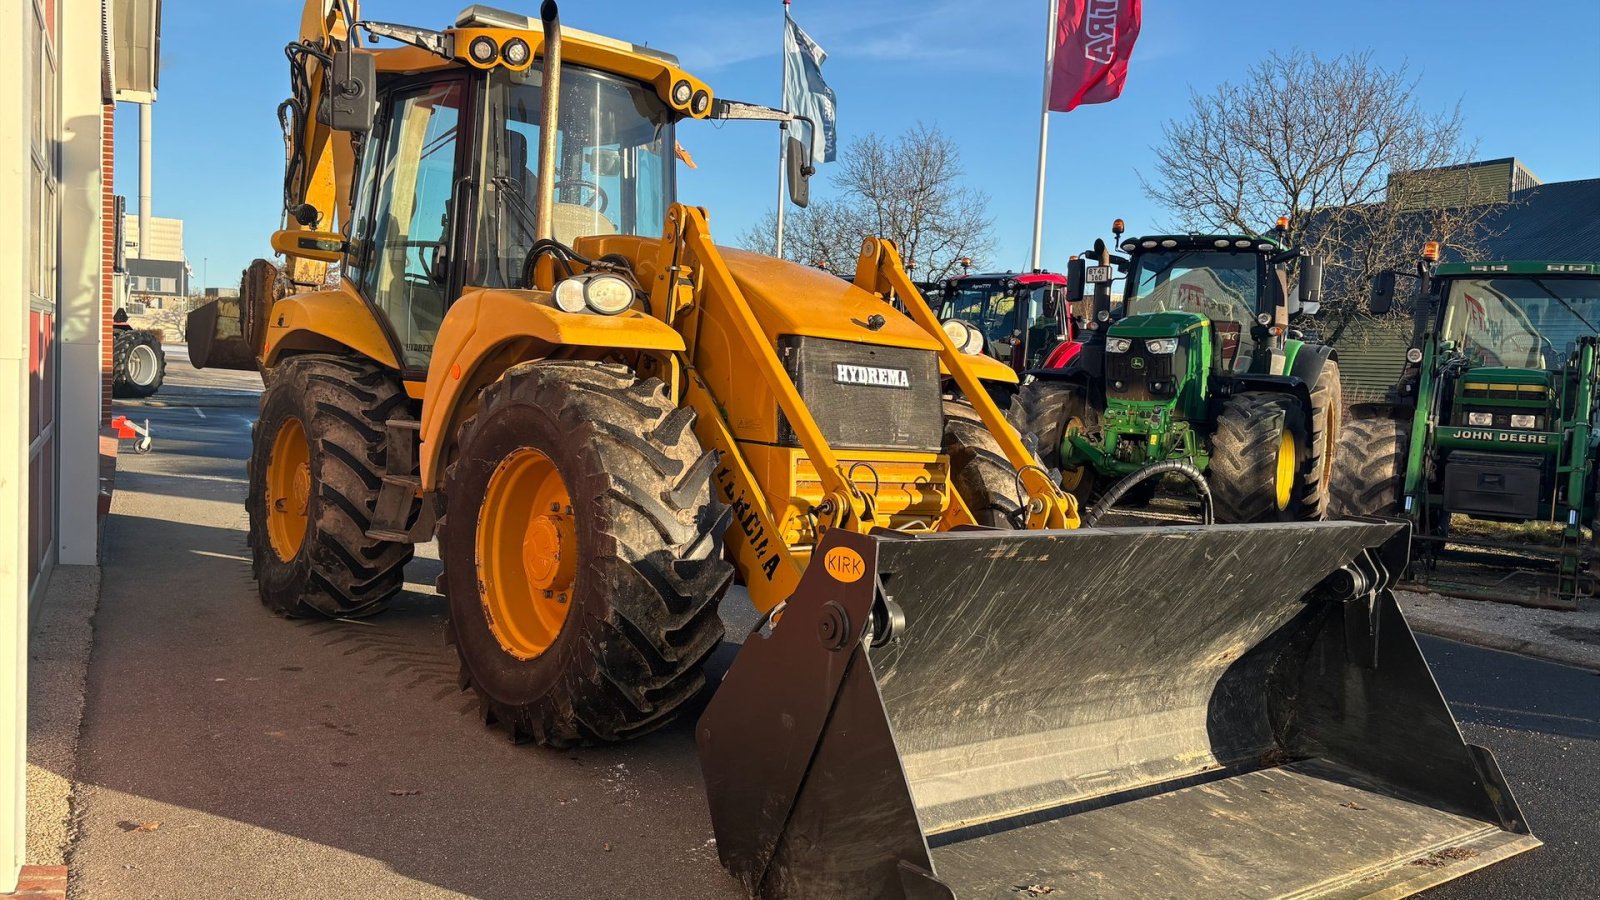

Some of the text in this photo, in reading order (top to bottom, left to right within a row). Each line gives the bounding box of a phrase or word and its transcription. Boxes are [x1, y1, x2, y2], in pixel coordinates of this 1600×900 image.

[825, 131, 833, 153] VAN
[406, 343, 433, 352] HYDREM
[836, 364, 910, 387] HYDREMA
[1453, 430, 1547, 444] JOHN DEERE
[828, 554, 862, 575] KIRK
